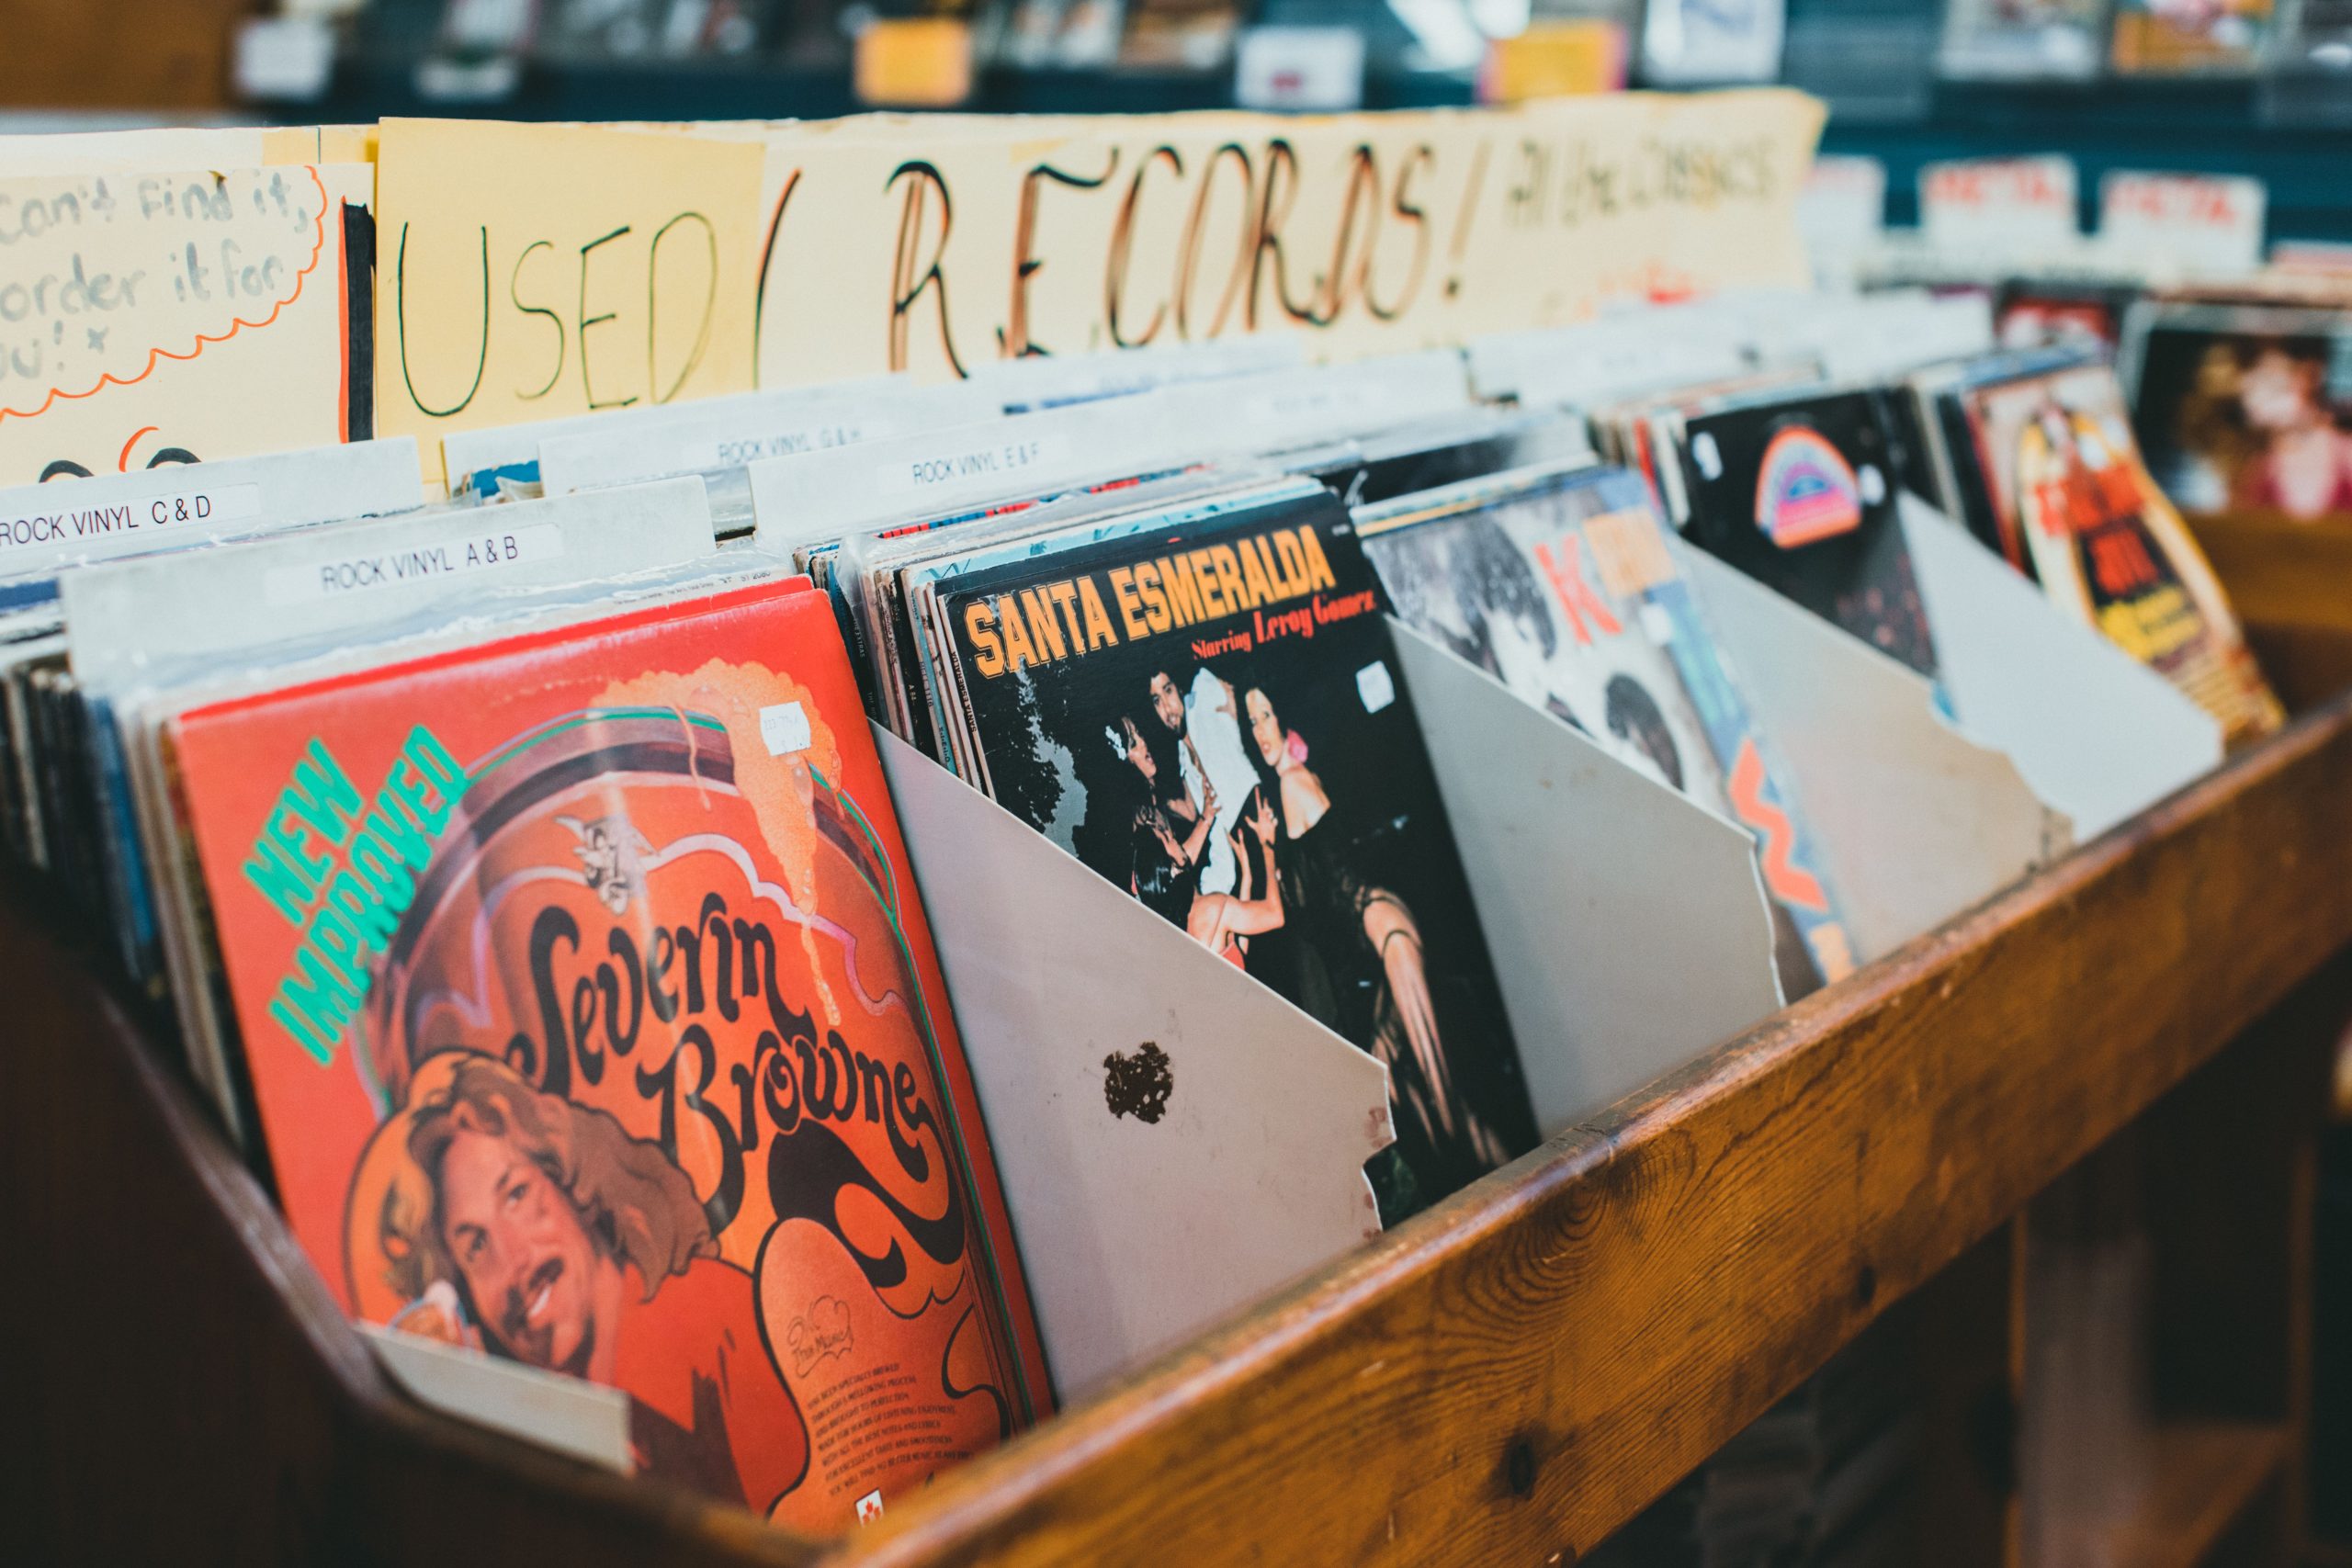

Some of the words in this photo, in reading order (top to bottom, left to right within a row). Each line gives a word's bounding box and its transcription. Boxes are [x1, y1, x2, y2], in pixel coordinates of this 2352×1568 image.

[0, 251, 147, 321] order
[168, 240, 211, 302] it
[398, 212, 718, 417] USED
[718, 439, 763, 464] ROCK
[912, 459, 955, 485] ROCK
[959, 452, 999, 476] VINYL
[0, 514, 66, 546] ROCK
[71, 505, 140, 536] VINYL
[152, 502, 168, 525] C
[175, 498, 191, 521] &
[197, 494, 211, 518] D
[322, 558, 386, 592] ROCK
[395, 547, 455, 581] VINYL
[467, 541, 481, 568] A
[486, 538, 500, 564] &
[505, 536, 519, 559] B
[963, 574, 1119, 680] SANTA
[1107, 524, 1338, 642] ESMERALDA
[1191, 629, 1254, 662] Starring
[1253, 605, 1315, 647] Leroy
[242, 736, 364, 926] NEW
[268, 723, 469, 1068] IMPROVED
[503, 891, 830, 1100] Severin
[635, 1021, 950, 1235] Browne
